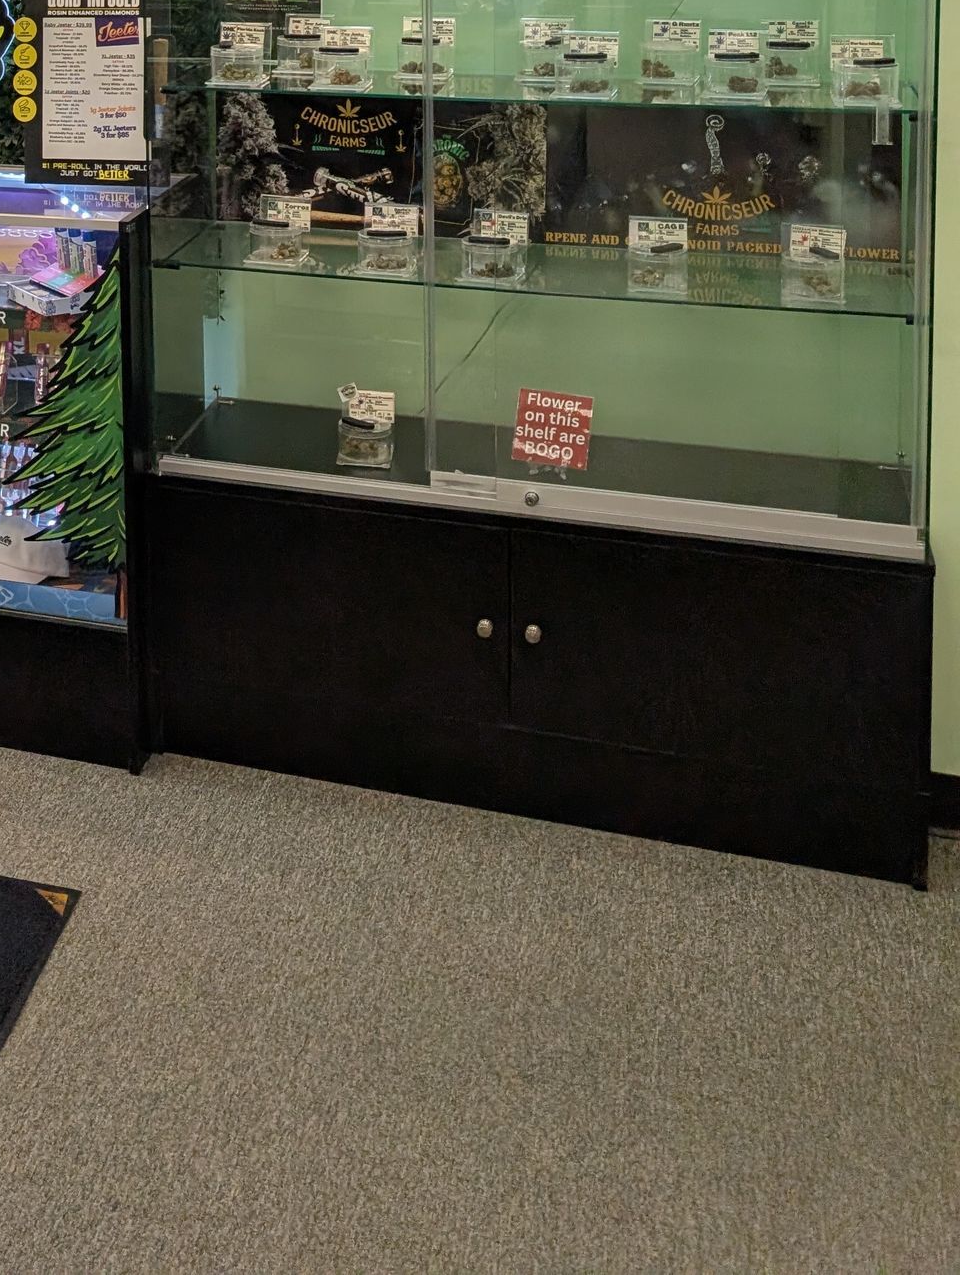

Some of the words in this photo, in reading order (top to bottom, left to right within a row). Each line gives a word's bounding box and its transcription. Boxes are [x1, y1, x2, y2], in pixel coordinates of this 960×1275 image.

[301, 107, 397, 134] CHRONICSEUR
[329, 135, 367, 147] FARMS
[98, 170, 130, 180] BETTER
[662, 189, 776, 221] CHRONICSEUR
[696, 223, 739, 236] FARMS
[592, 235, 620, 246] AND
[727, 241, 781, 254] PACKED
[527, 392, 582, 411] Flower
[525, 411, 544, 422] on
[549, 410, 580, 428] this
[515, 424, 556, 441] shelf
[559, 433, 586, 445] are
[524, 440, 573, 461] BOGO
